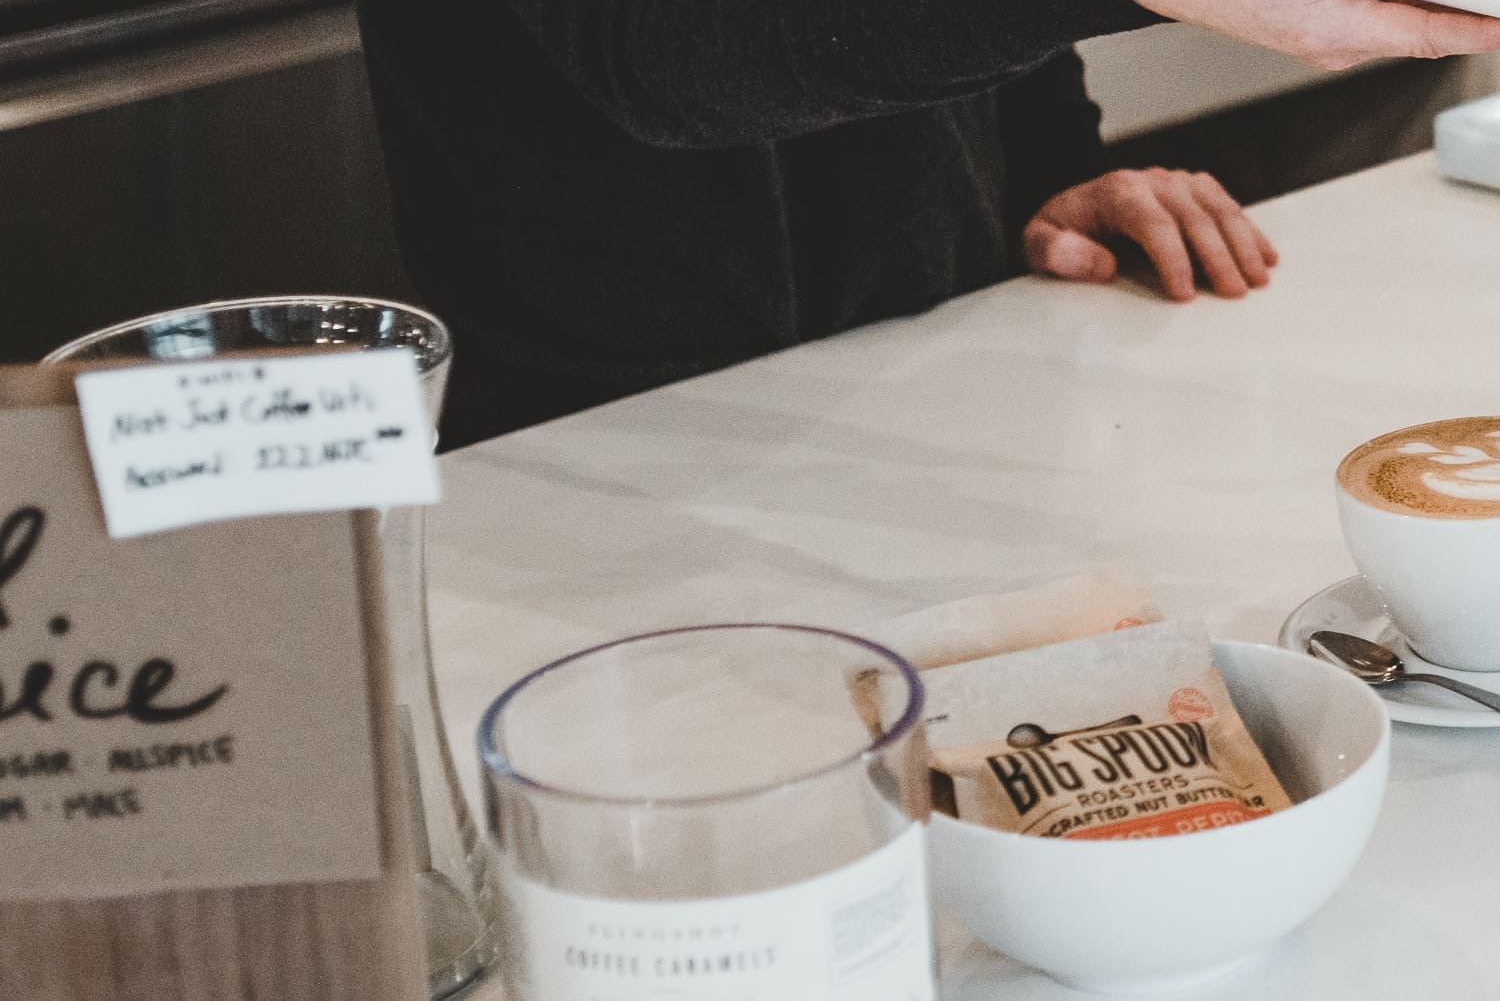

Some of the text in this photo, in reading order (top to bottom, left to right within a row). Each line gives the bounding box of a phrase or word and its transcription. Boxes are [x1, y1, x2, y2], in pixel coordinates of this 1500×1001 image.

[987, 721, 1218, 816] BIG SPOON
[1076, 774, 1190, 808] ROASTERS
[1040, 805, 1129, 837] CRAFTED
[1134, 796, 1168, 814] NUT
[566, 944, 777, 978] COFFEE CARAMELS
